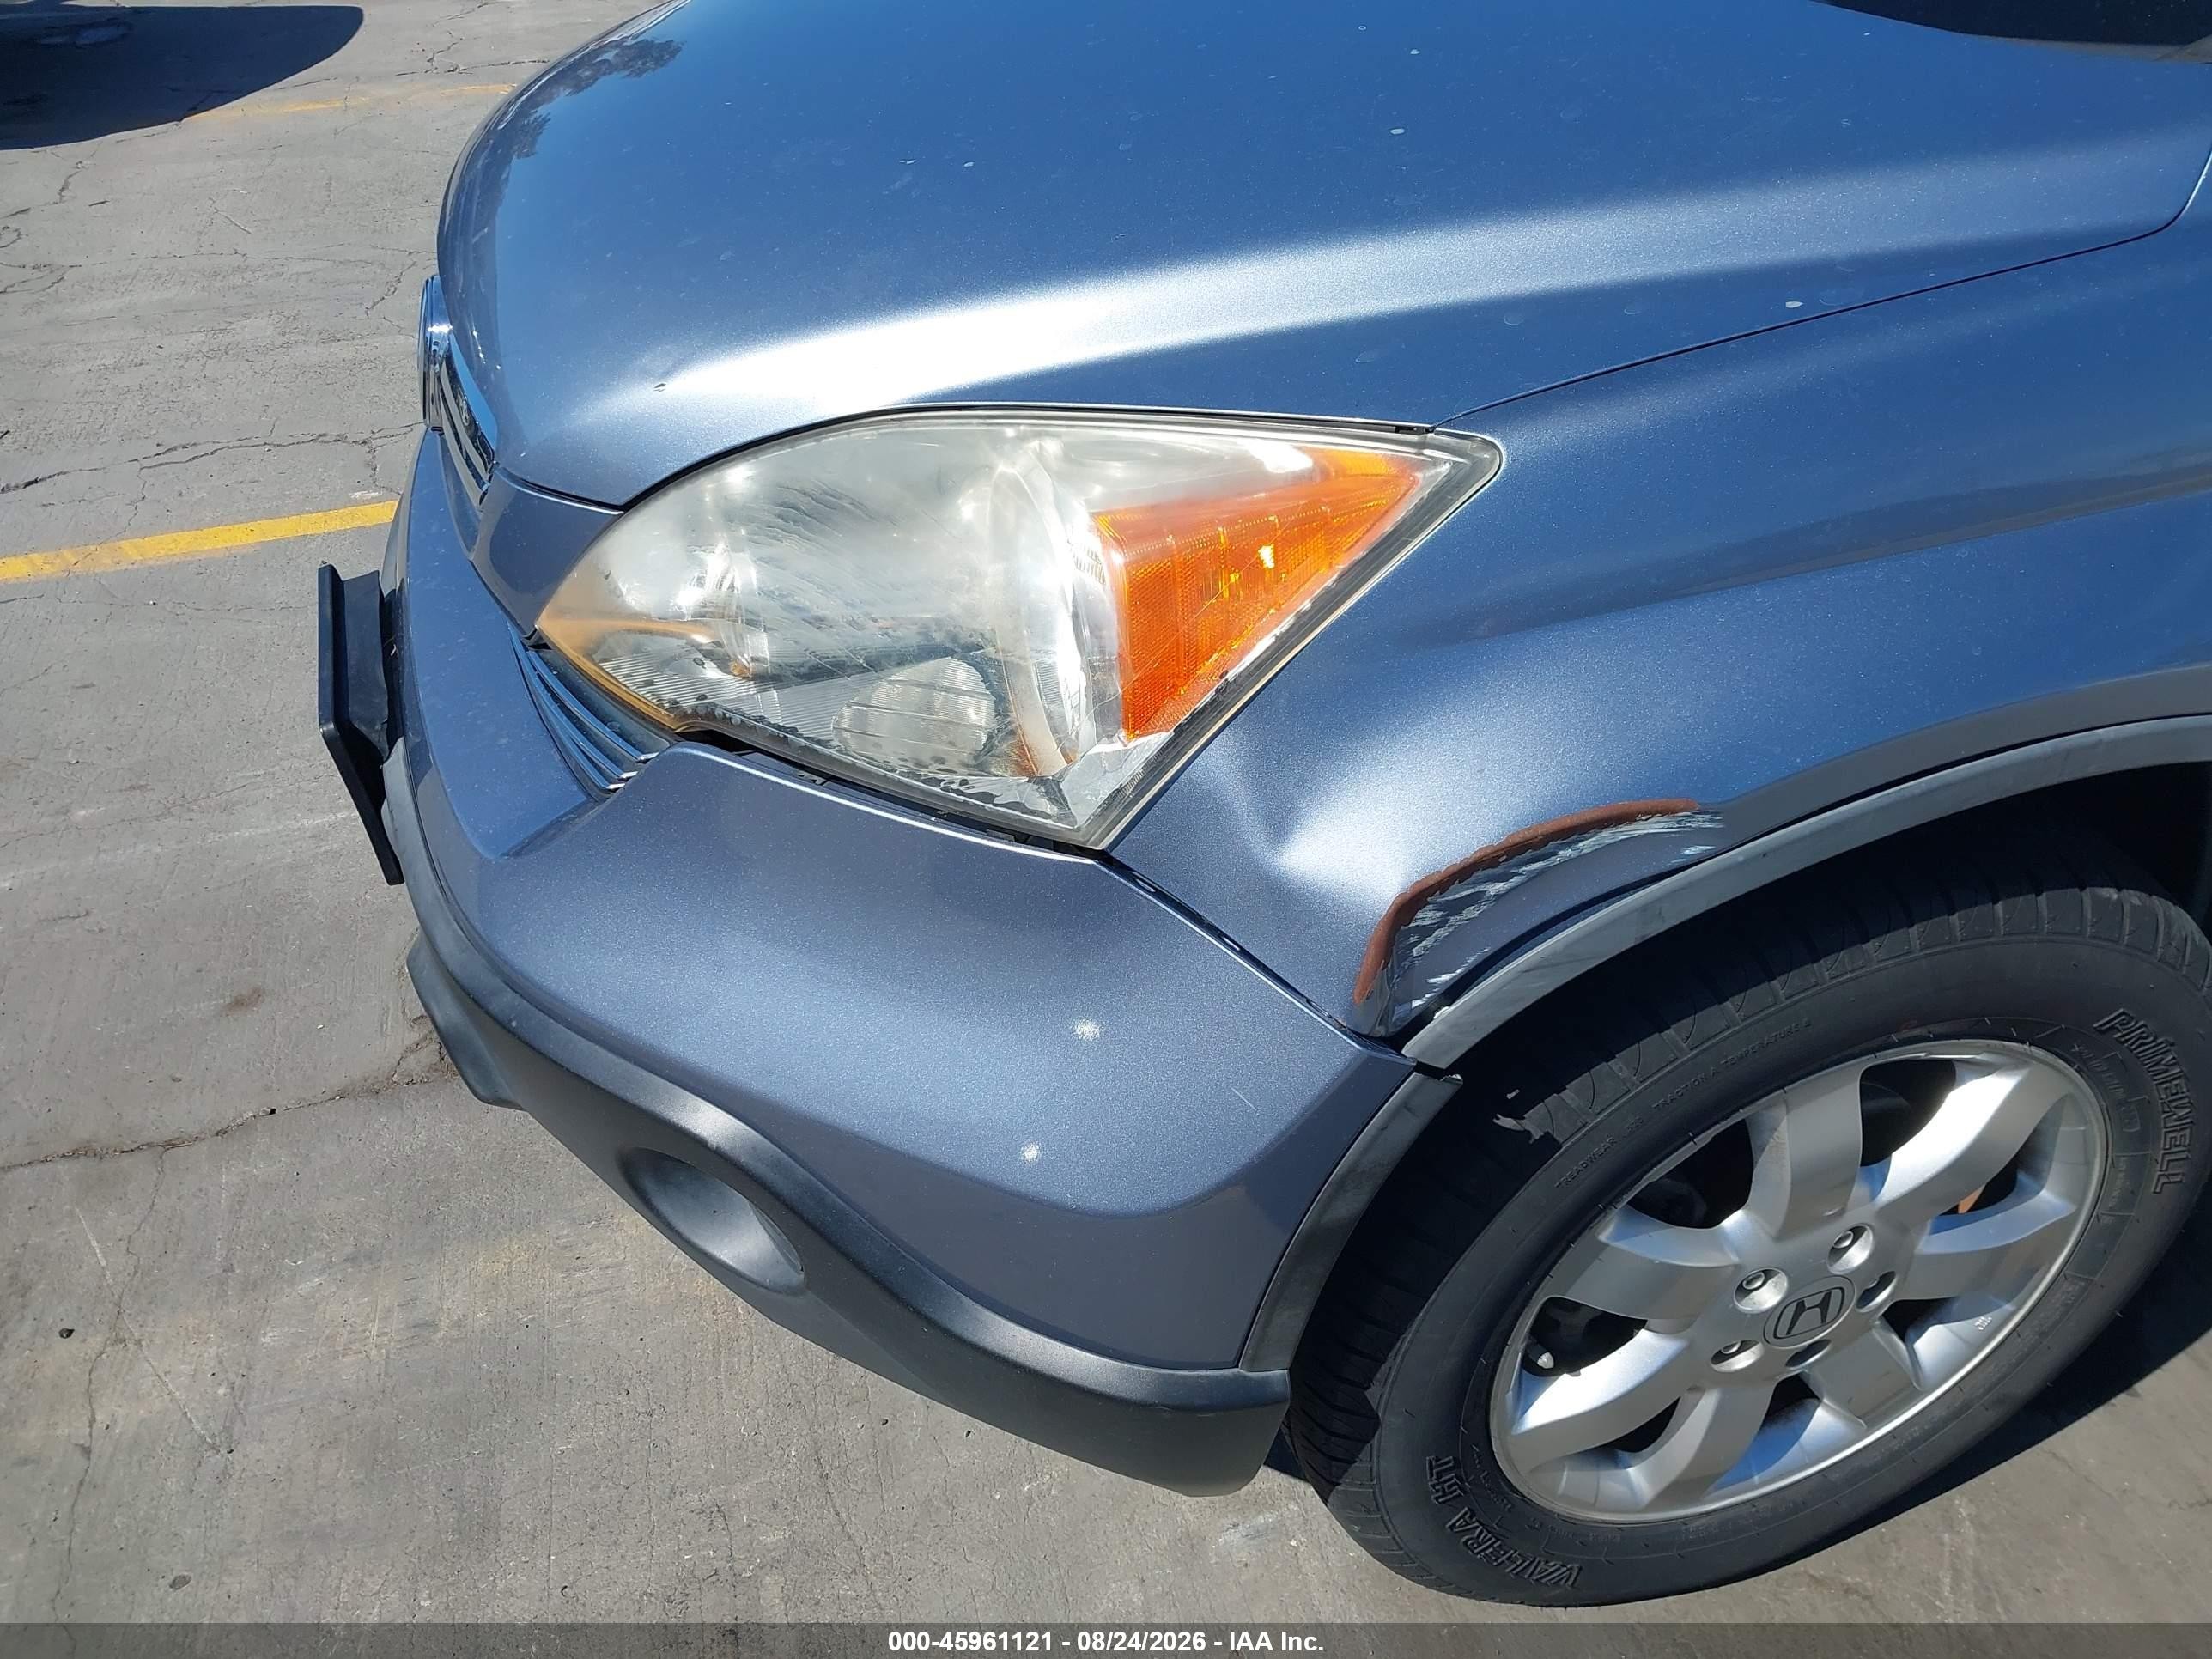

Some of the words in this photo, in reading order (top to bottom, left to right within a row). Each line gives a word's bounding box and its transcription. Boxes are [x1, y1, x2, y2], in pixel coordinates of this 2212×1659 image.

[1553, 1133, 1618, 1188] TREADWEAR
[1651, 1073, 1708, 1110] TRACTION
[1720, 1022, 1802, 1066] TEMPERATURE
[2092, 1007, 2198, 1194] PRIMEWELL
[1444, 1505, 1583, 1589] VALERA
